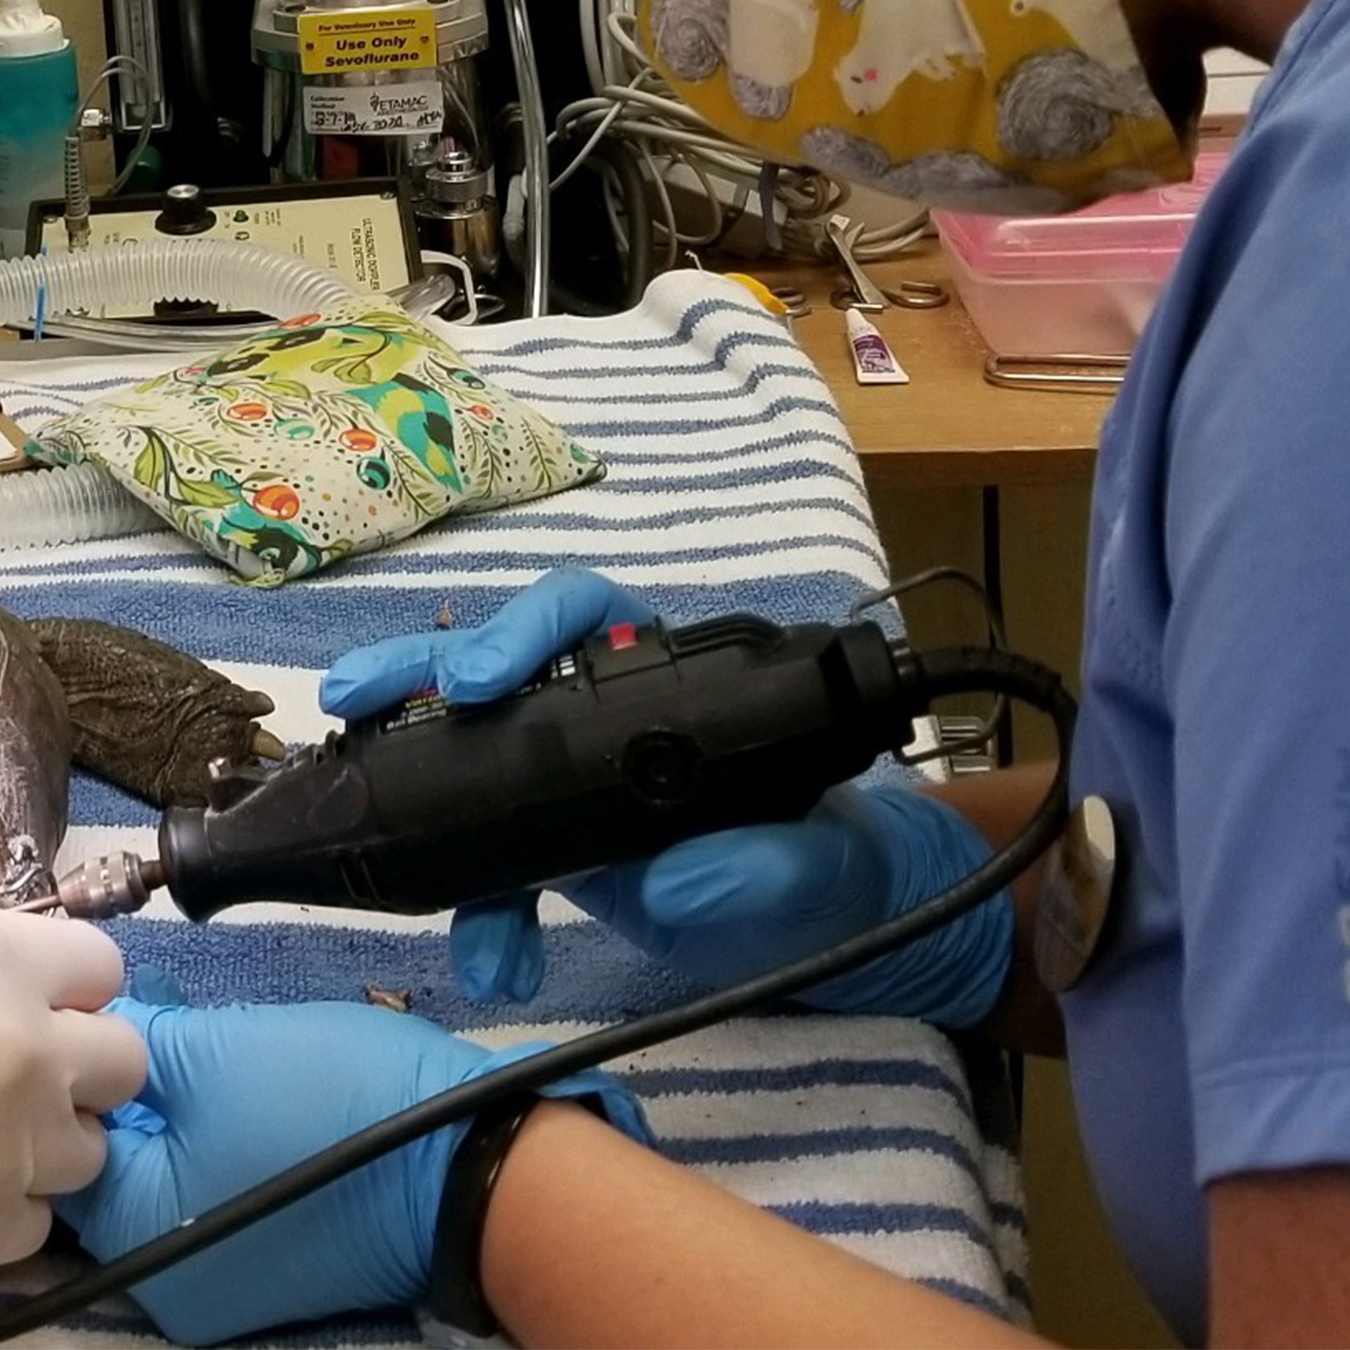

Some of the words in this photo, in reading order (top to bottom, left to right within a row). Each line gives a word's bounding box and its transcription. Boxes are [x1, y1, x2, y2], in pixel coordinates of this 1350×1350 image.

[318, 24, 332, 32] For
[334, 21, 377, 31] Veterinary
[378, 19, 395, 27] Use
[396, 18, 416, 26] Only
[336, 39, 366, 51] Use
[371, 36, 407, 49] Only
[325, 51, 420, 68] Sevoflurane
[351, 228, 362, 245] FLOW
[353, 246, 366, 282] DETECTOR
[367, 259, 380, 291] DOPPLER
